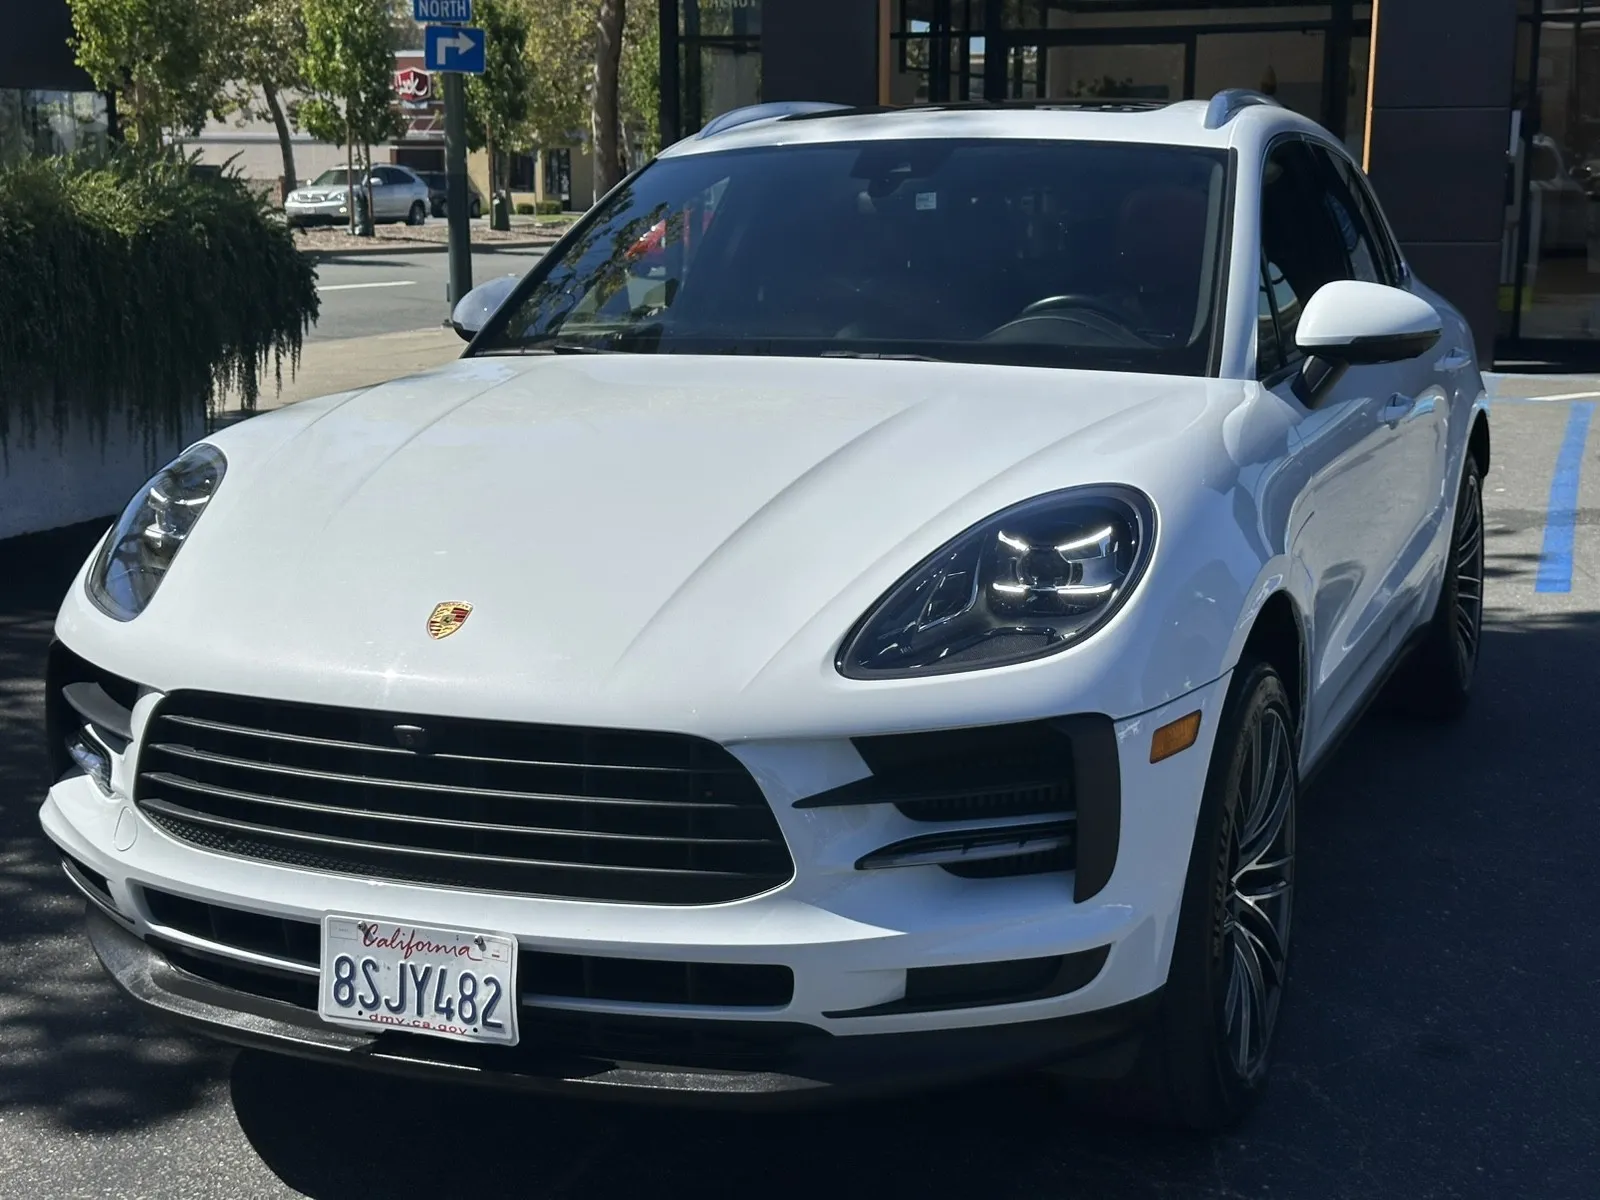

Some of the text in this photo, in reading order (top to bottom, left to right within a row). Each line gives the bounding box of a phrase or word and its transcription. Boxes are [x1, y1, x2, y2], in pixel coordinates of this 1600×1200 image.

[419, 0, 467, 17] NORTH
[363, 923, 483, 962] California
[333, 955, 504, 1028] 8SJY482
[369, 1013, 468, 1035] dmv.ca.gov
